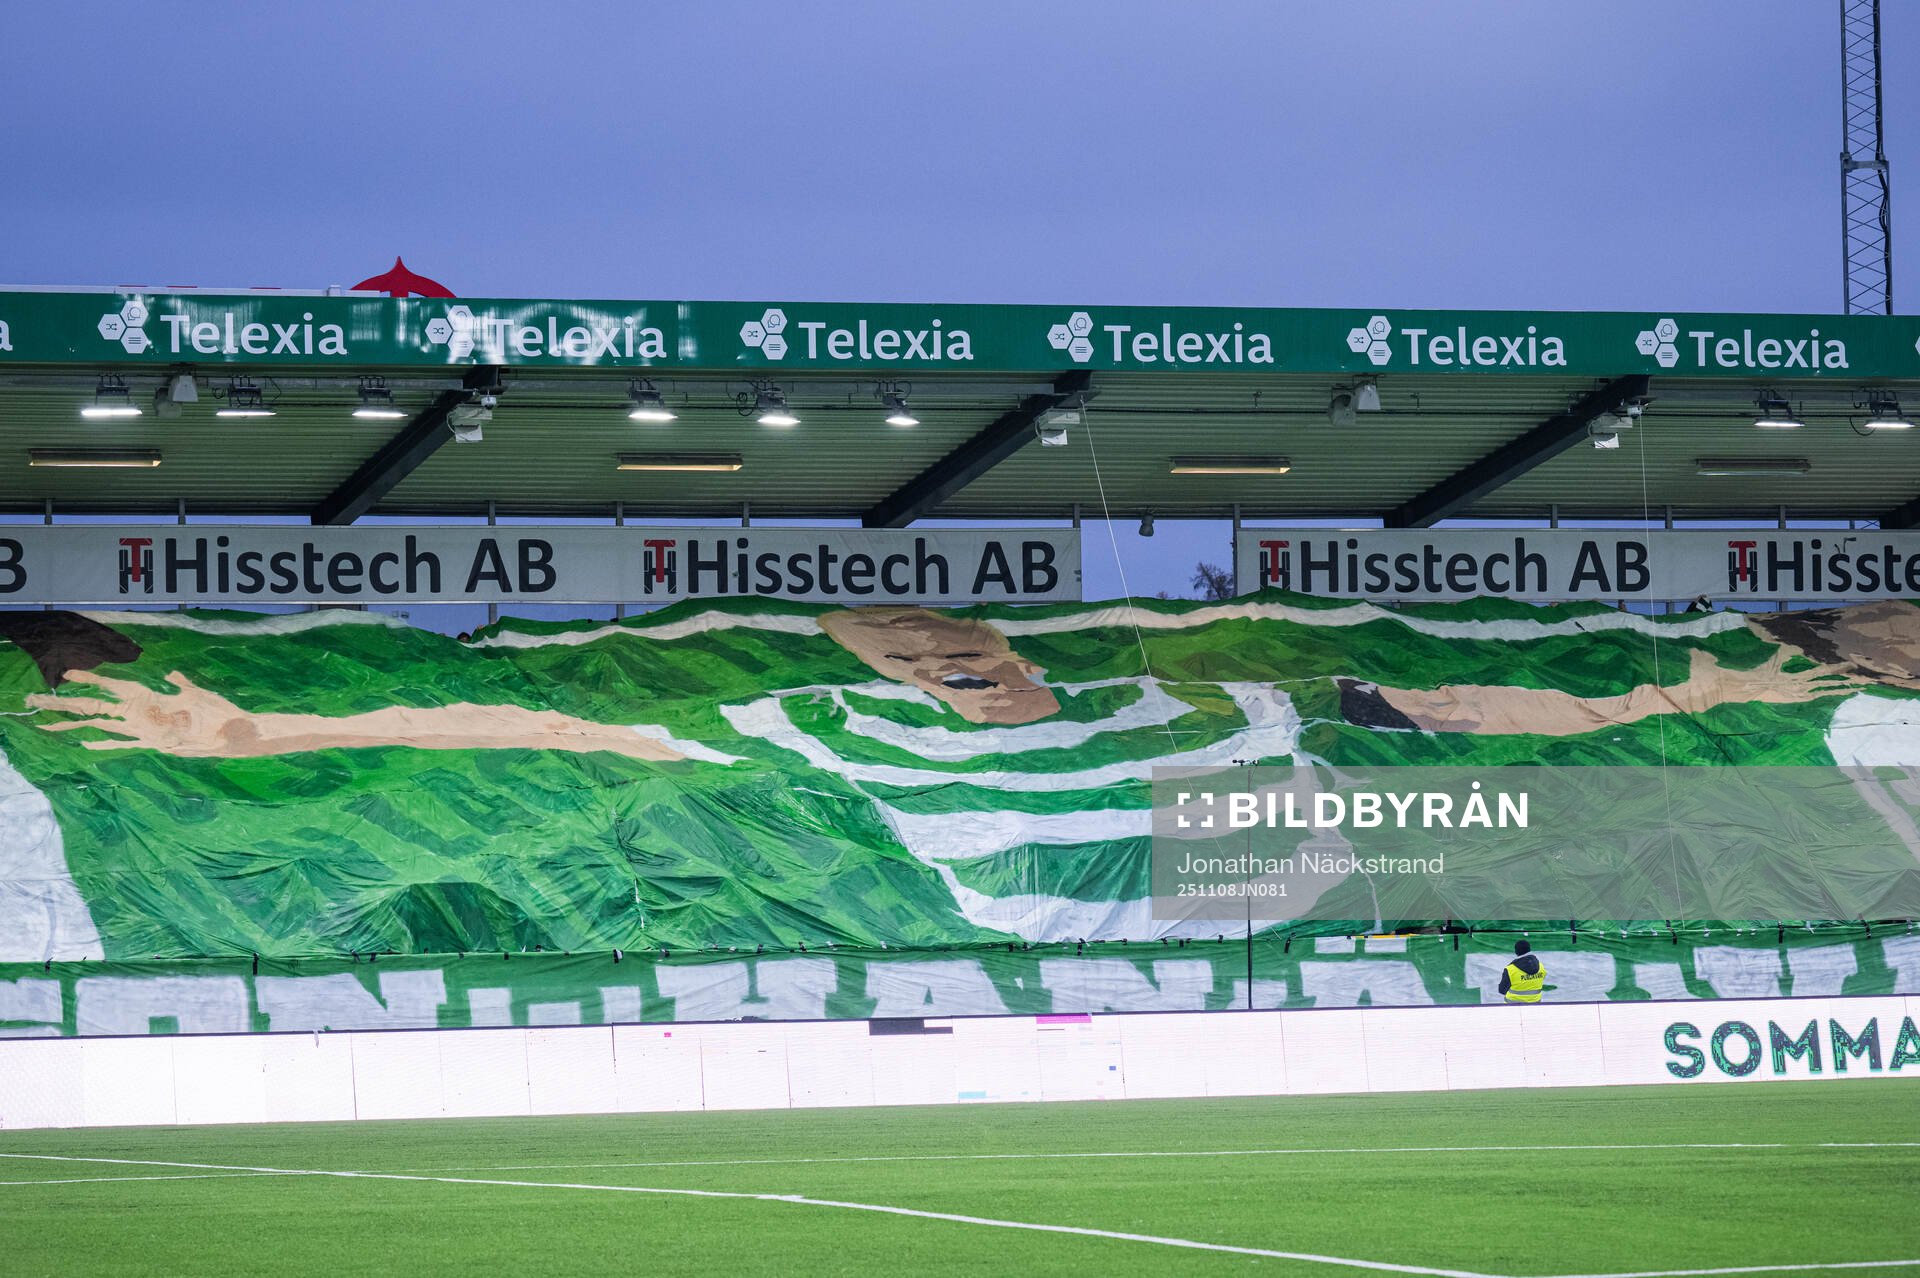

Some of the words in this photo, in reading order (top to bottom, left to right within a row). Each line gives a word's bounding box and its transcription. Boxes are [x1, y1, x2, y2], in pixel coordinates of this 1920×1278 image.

[161, 311, 348, 355] Telexia
[490, 315, 667, 359] Telexia
[799, 319, 973, 361] Telexia
[1104, 322, 1274, 363] Telexia
[1402, 326, 1567, 366] Telexia
[1689, 330, 1849, 369] Telexia
[166, 535, 441, 595] Hisstech
[465, 539, 557, 594] AB
[688, 535, 949, 594] Hisstech
[972, 541, 1059, 594] AB
[1301, 537, 1548, 594] Hisstech
[1569, 541, 1651, 593] AB
[1664, 1016, 1920, 1078] SOMMA
